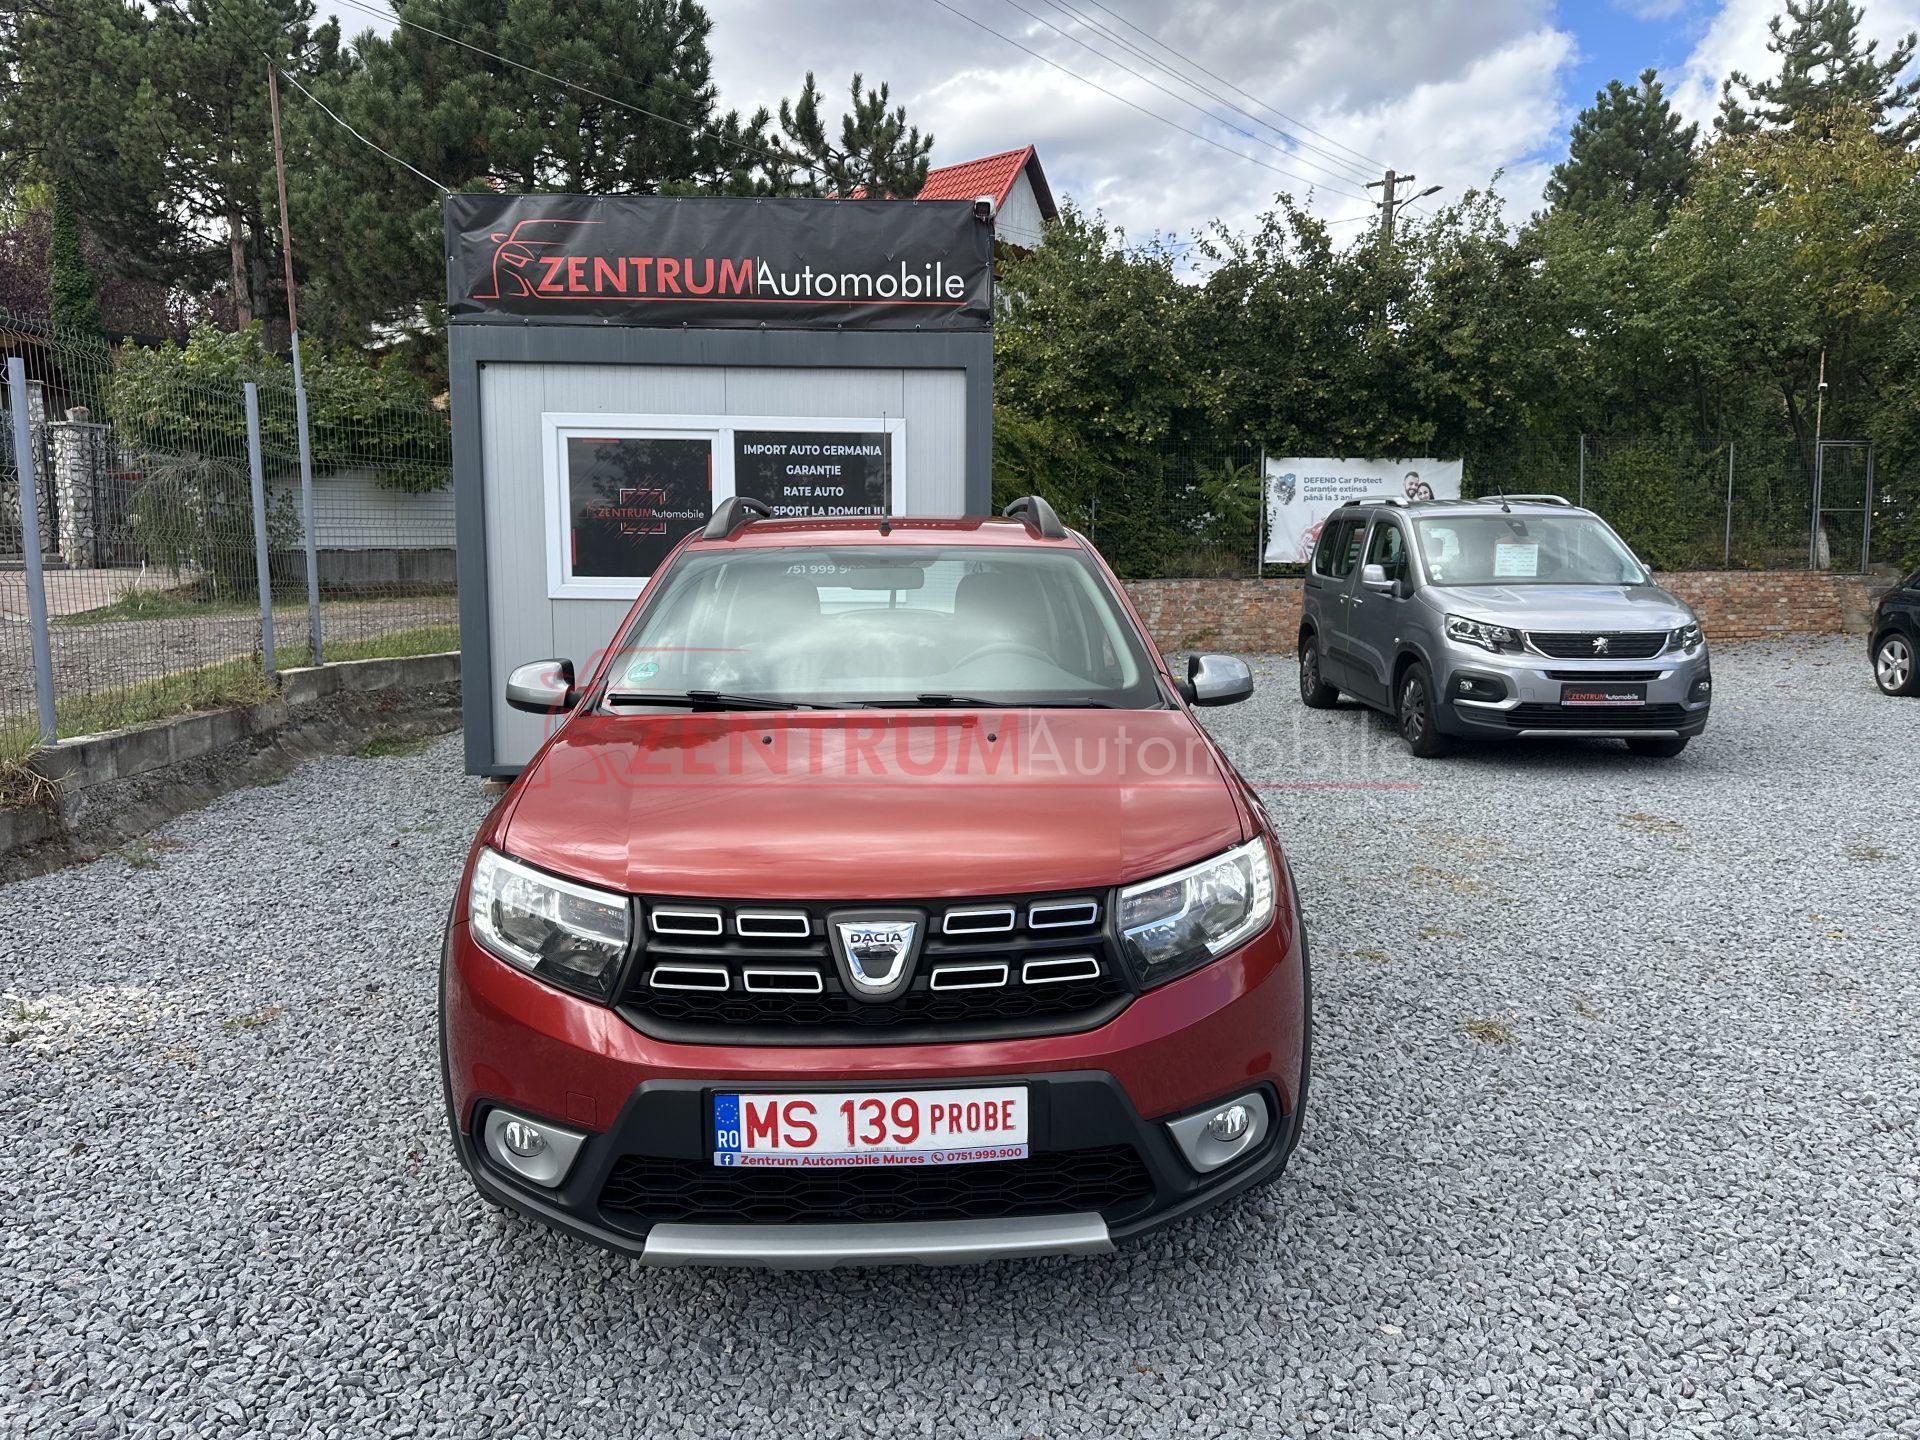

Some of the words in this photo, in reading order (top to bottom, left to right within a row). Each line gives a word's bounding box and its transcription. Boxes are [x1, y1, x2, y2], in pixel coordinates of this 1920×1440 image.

[743, 444, 787, 455] IMPORT
[789, 445, 820, 455] AUTO
[822, 445, 882, 456] GERMANIA
[786, 465, 841, 477] GARANȚIE
[783, 487, 811, 496] RATE
[814, 487, 844, 496] AUTO
[743, 505, 809, 516] TSPORT
[811, 506, 826, 516] LA
[809, 564, 836, 574] 999
[850, 933, 903, 943] DACIA
[745, 1101, 818, 1148] MS
[840, 1098, 919, 1145] 139
[930, 1099, 1017, 1135] PROBE
[718, 1130, 739, 1148] RO
[741, 1155, 798, 1166] Zentrum
[801, 1155, 880, 1166] Automobile
[883, 1154, 925, 1165] Mures
[947, 1147, 1022, 1162] 0751.999.900
